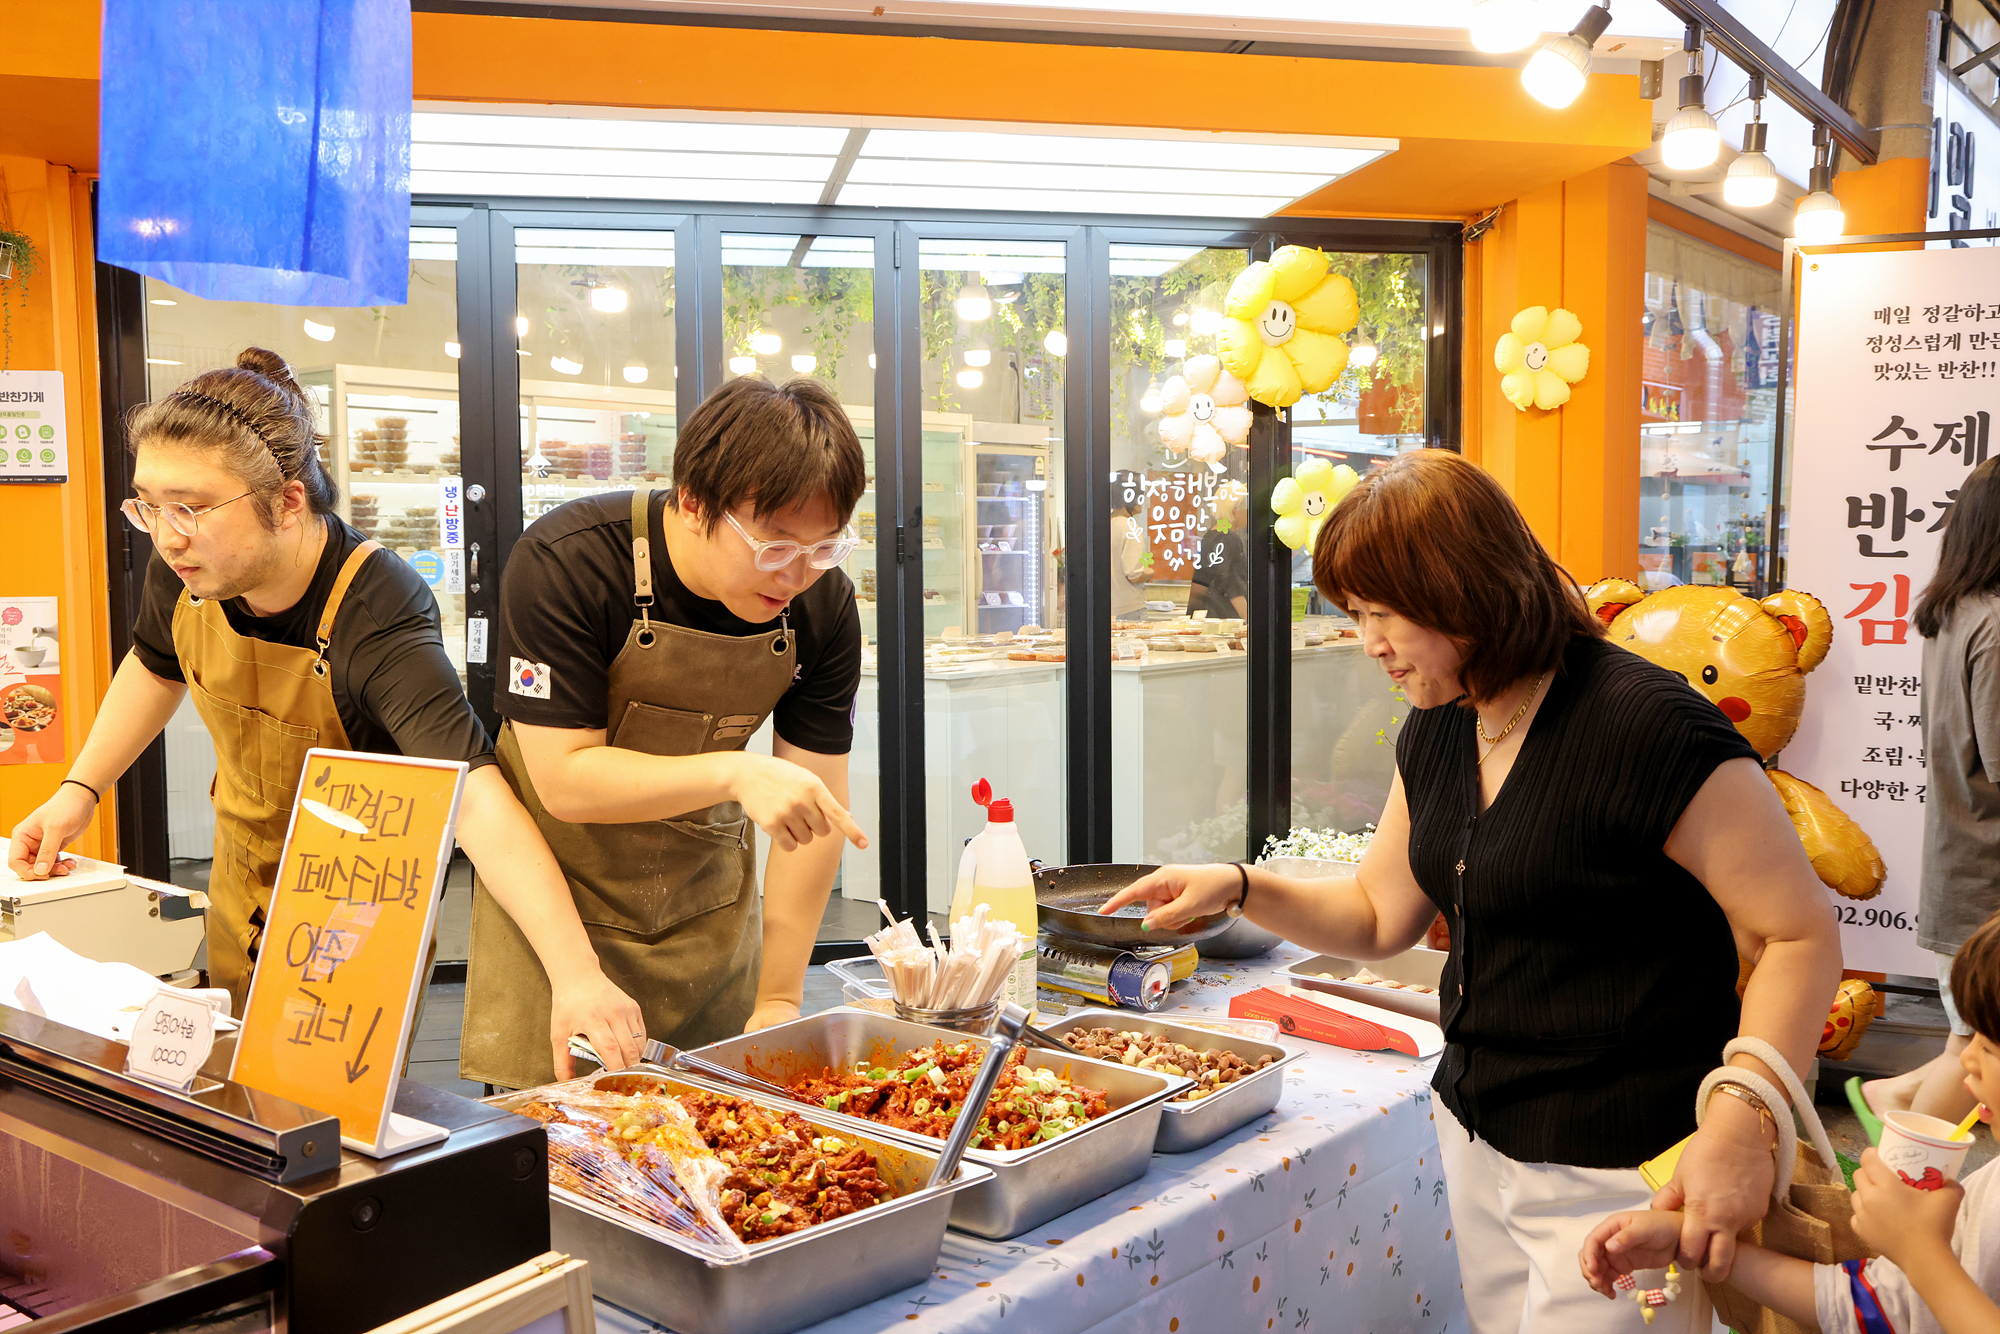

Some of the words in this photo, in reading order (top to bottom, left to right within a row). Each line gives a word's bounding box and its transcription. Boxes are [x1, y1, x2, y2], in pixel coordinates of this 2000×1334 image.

[1873, 305, 1911, 325] 매일
[1922, 302, 2000, 324] 정갈하고
[1865, 332, 1961, 354] 정성스럽게
[1873, 361, 1932, 382] 맛있는
[1937, 360, 1996, 380] 반찬!!
[0, 391, 45, 403] 반찬가게
[1865, 410, 1991, 472] 수제
[524, 483, 565, 497] OPEN
[524, 503, 560, 517] CLO
[450, 551, 459, 584] 당기세요
[472, 620, 482, 652] 당기세요
[1853, 674, 1922, 697] 밑반찬
[1840, 778, 1910, 802] 다양한
[286, 921, 347, 985] 안주
[286, 986, 353, 1046] 코너
[1243, 1011, 1260, 1020] GOOD
